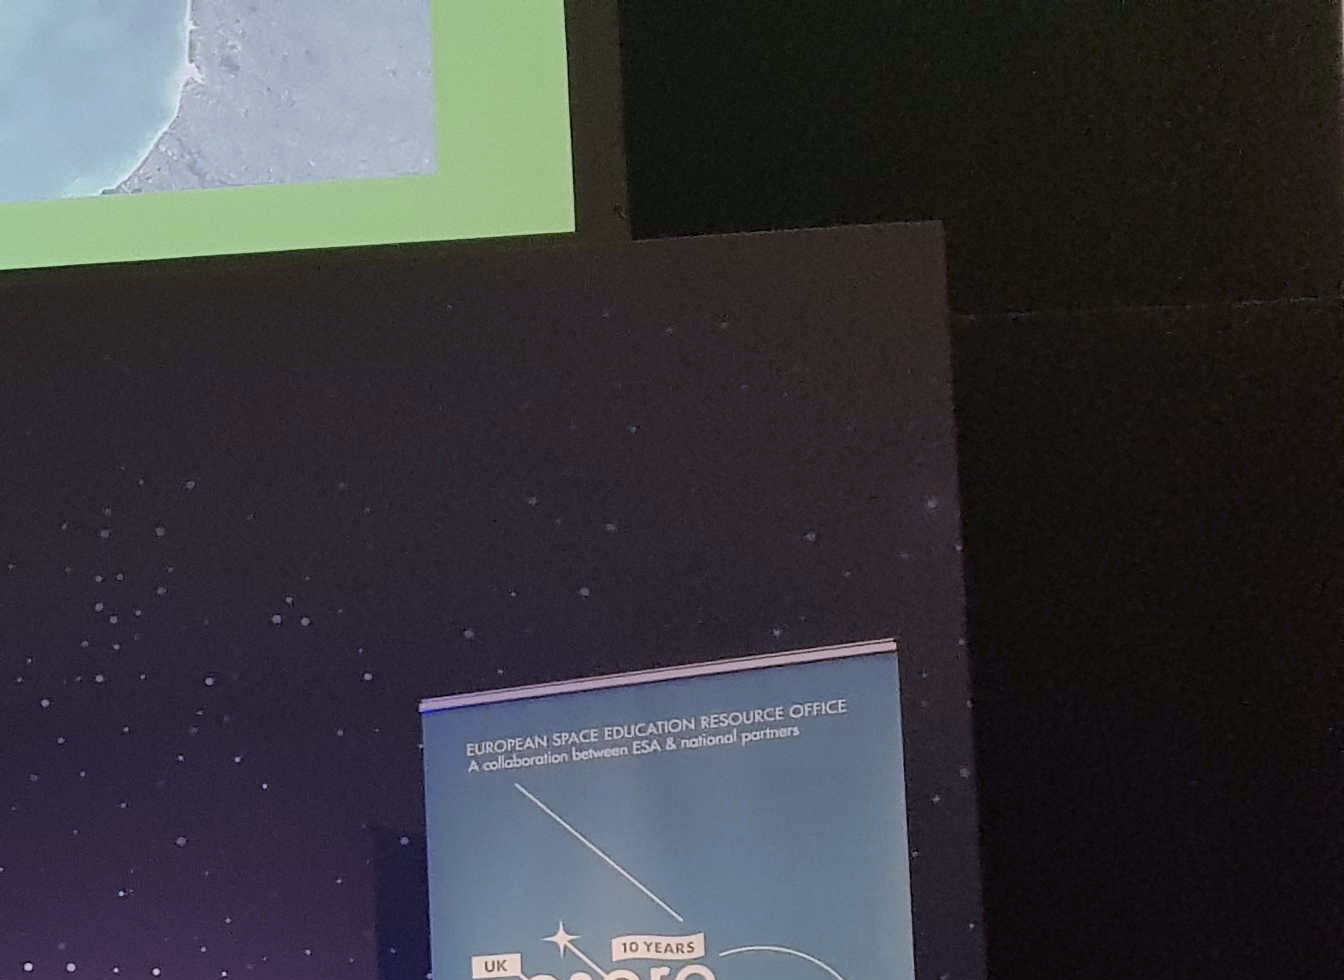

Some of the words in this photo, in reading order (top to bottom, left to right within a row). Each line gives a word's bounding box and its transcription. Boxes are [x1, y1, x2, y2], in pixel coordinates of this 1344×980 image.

[466, 735, 547, 757] EUROPEAN
[552, 728, 599, 747] SPACE
[604, 716, 695, 740] EDUCATION
[700, 706, 785, 729] RESOURCE
[789, 699, 848, 719] OFFICE
[468, 760, 480, 773] A
[483, 752, 568, 771] collaboration
[572, 746, 629, 761] between
[633, 741, 662, 755] ESA
[665, 738, 677, 750] &
[681, 729, 737, 749] national
[741, 726, 800, 747] partners
[621, 941, 639, 956] 10
[643, 940, 696, 956] YEARS
[484, 958, 508, 974] UK
